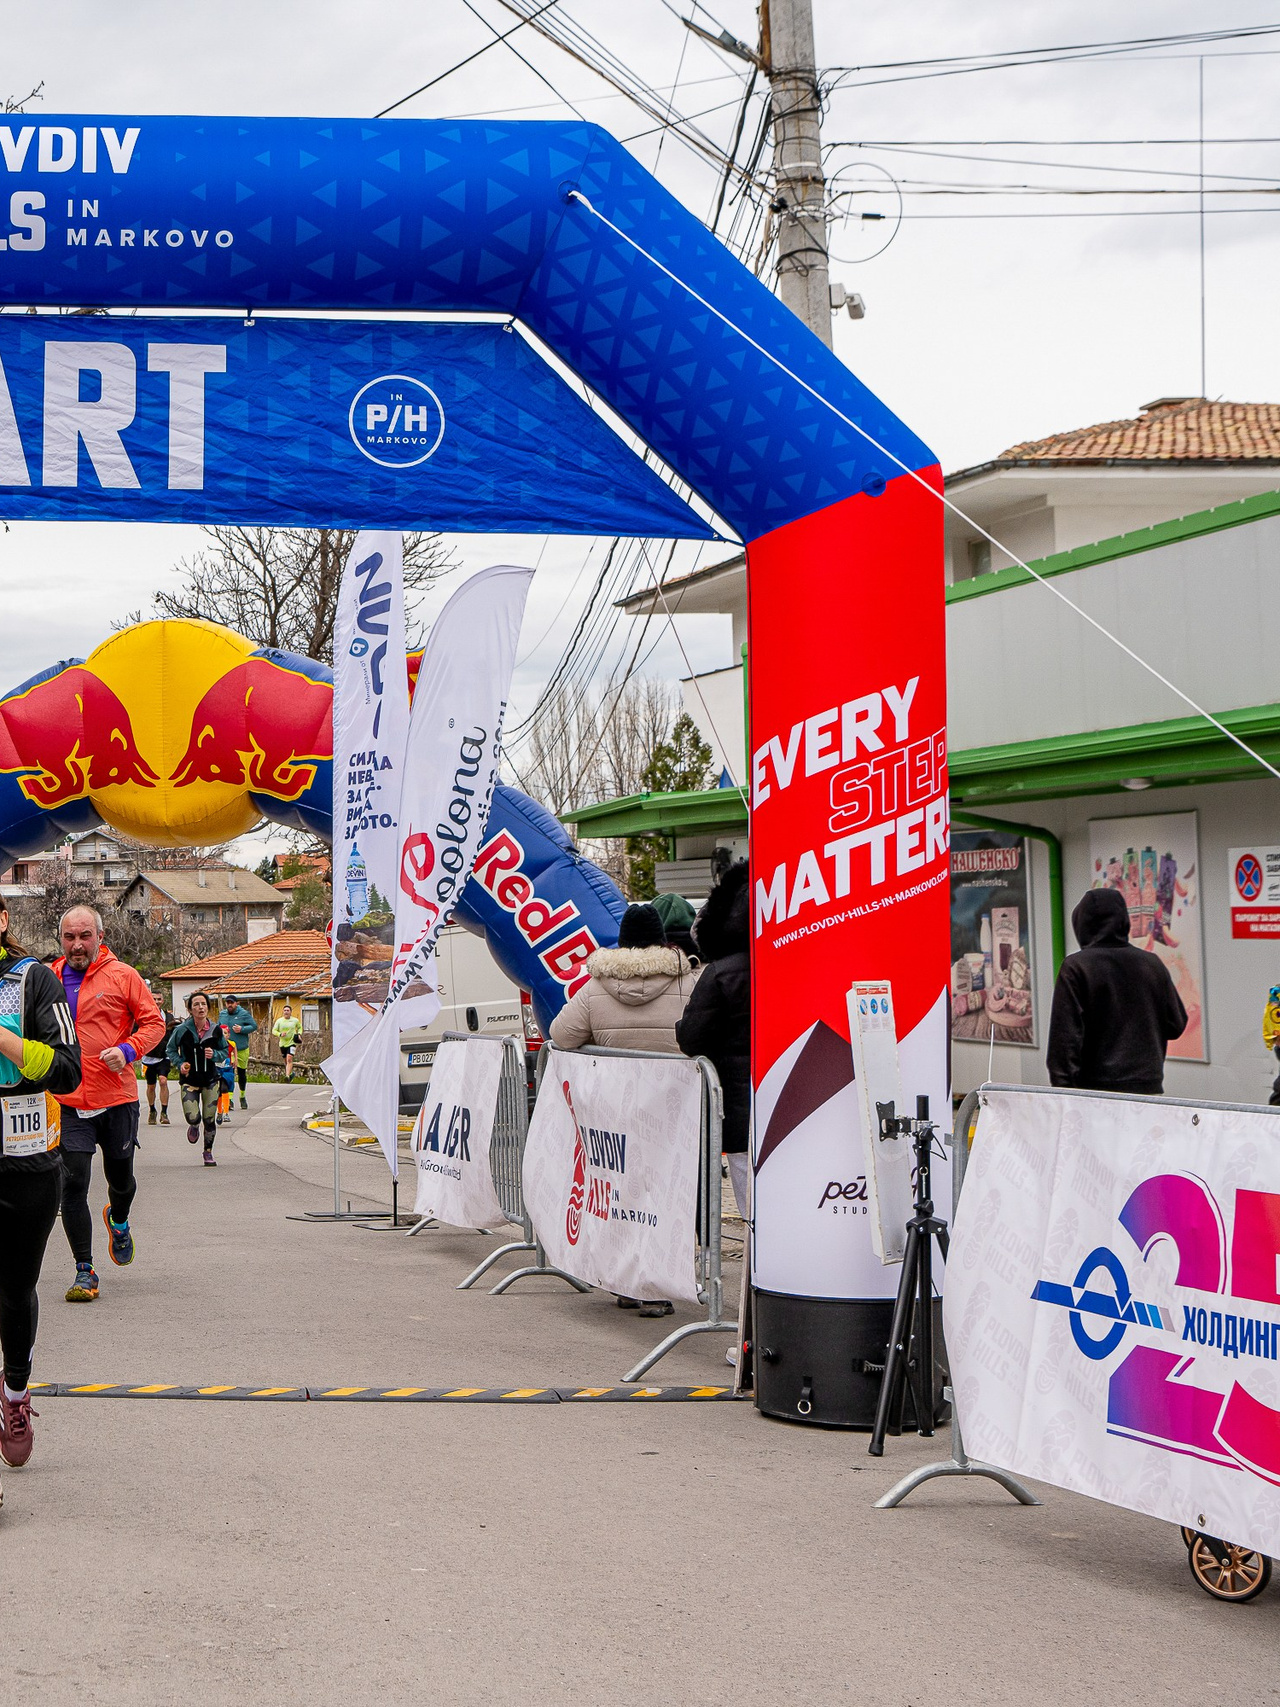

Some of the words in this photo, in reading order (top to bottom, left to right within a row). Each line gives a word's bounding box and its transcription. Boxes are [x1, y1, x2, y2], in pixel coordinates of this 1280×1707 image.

[66, 199, 99, 218] IN
[66, 228, 234, 248] MARKOVO
[390, 393, 403, 401] IN
[366, 404, 428, 434] P/H
[366, 436, 427, 445] MARKOVO
[753, 675, 919, 811] EVERY
[829, 726, 947, 833] STEP
[951, 847, 1019, 873] НАШЕНСКО
[472, 833, 575, 943] Red
[773, 868, 948, 949] WWW.PLOVDIV-HILLS-IN-MARKOVO.COM
[422, 1052, 437, 1063] 027
[10, 1112, 41, 1133] 1118
[612, 1189, 619, 1202] IN
[611, 1207, 658, 1227] MARKOVO
[833, 1206, 868, 1215] STUD
[1182, 1305, 1280, 1360] ХОЛДИНГ
